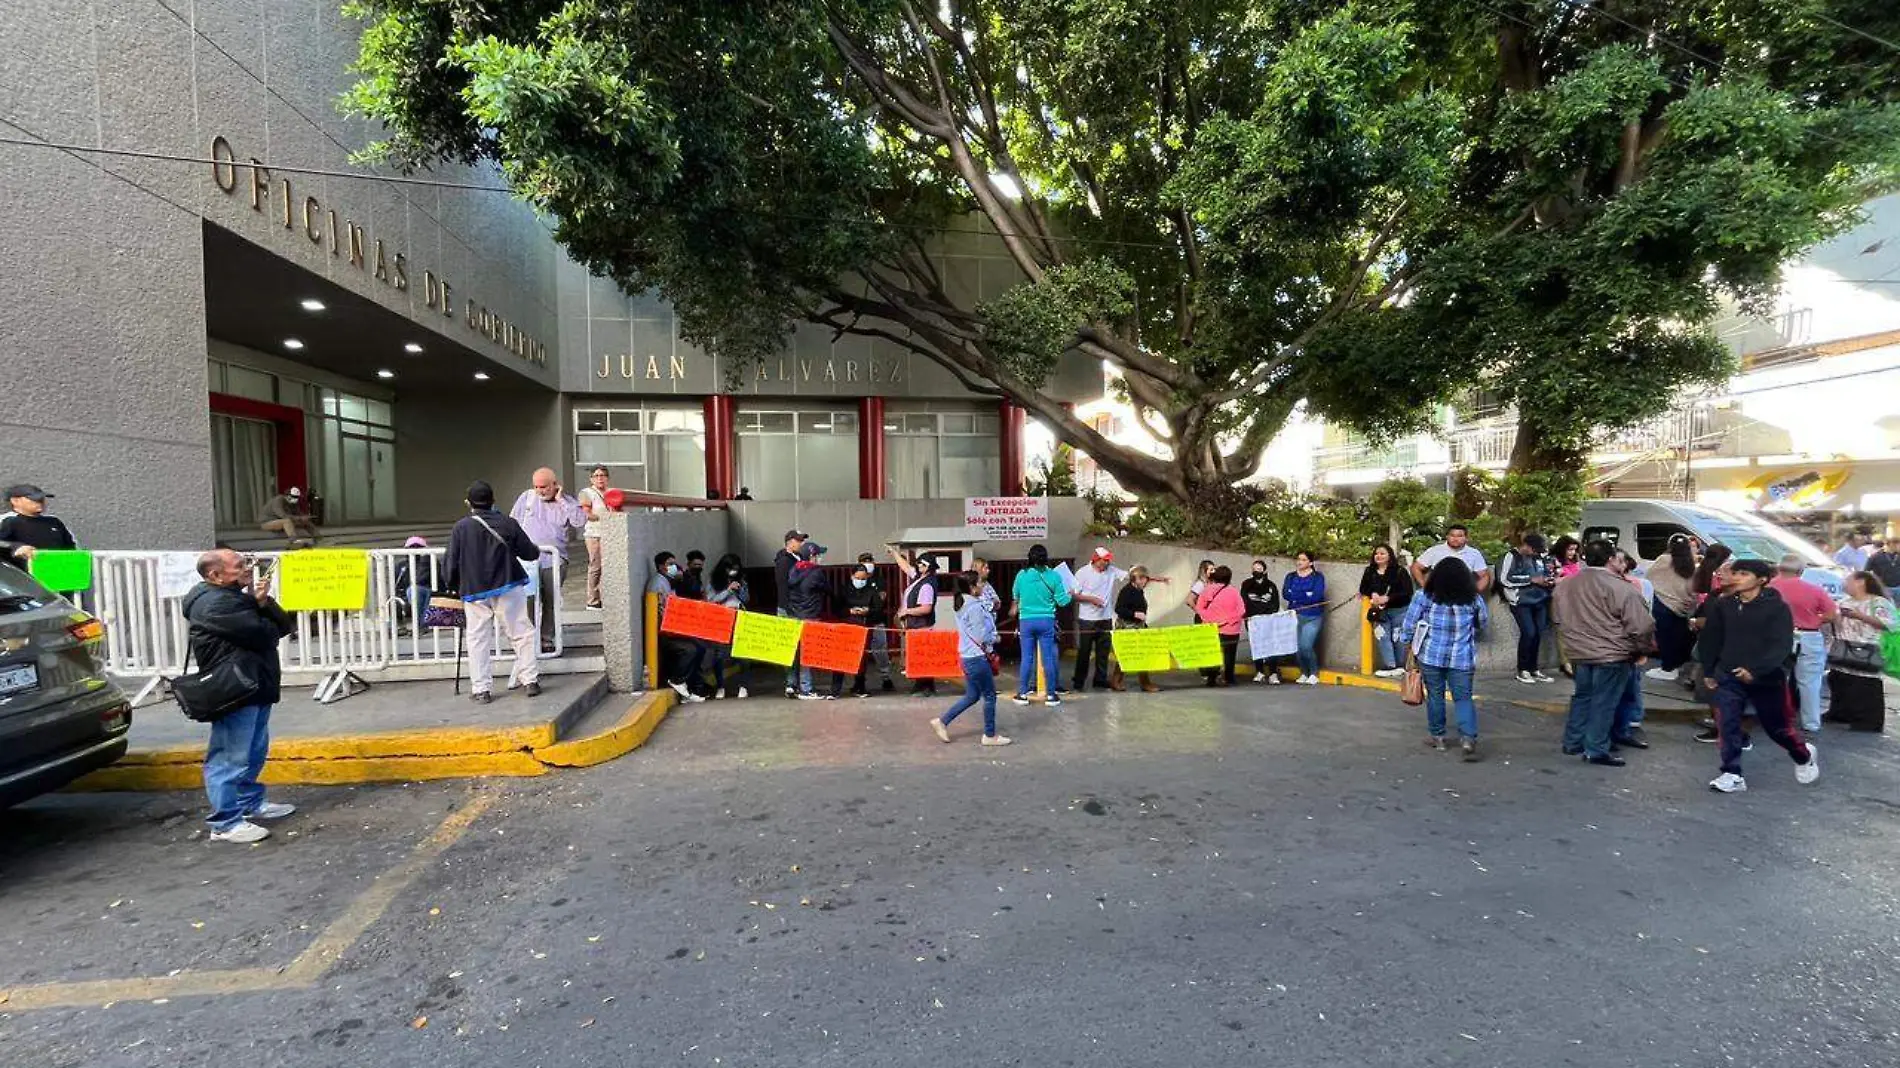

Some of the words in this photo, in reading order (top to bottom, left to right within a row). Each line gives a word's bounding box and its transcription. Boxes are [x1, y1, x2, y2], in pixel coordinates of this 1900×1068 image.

[211, 135, 407, 290] OFICINAS
[425, 269, 452, 317] DE
[465, 298, 547, 365] GOBIERNO
[597, 355, 686, 380] JUAN
[755, 357, 902, 382] ALVAREZ
[973, 499, 988, 507] Sin
[989, 517, 1007, 525] con
